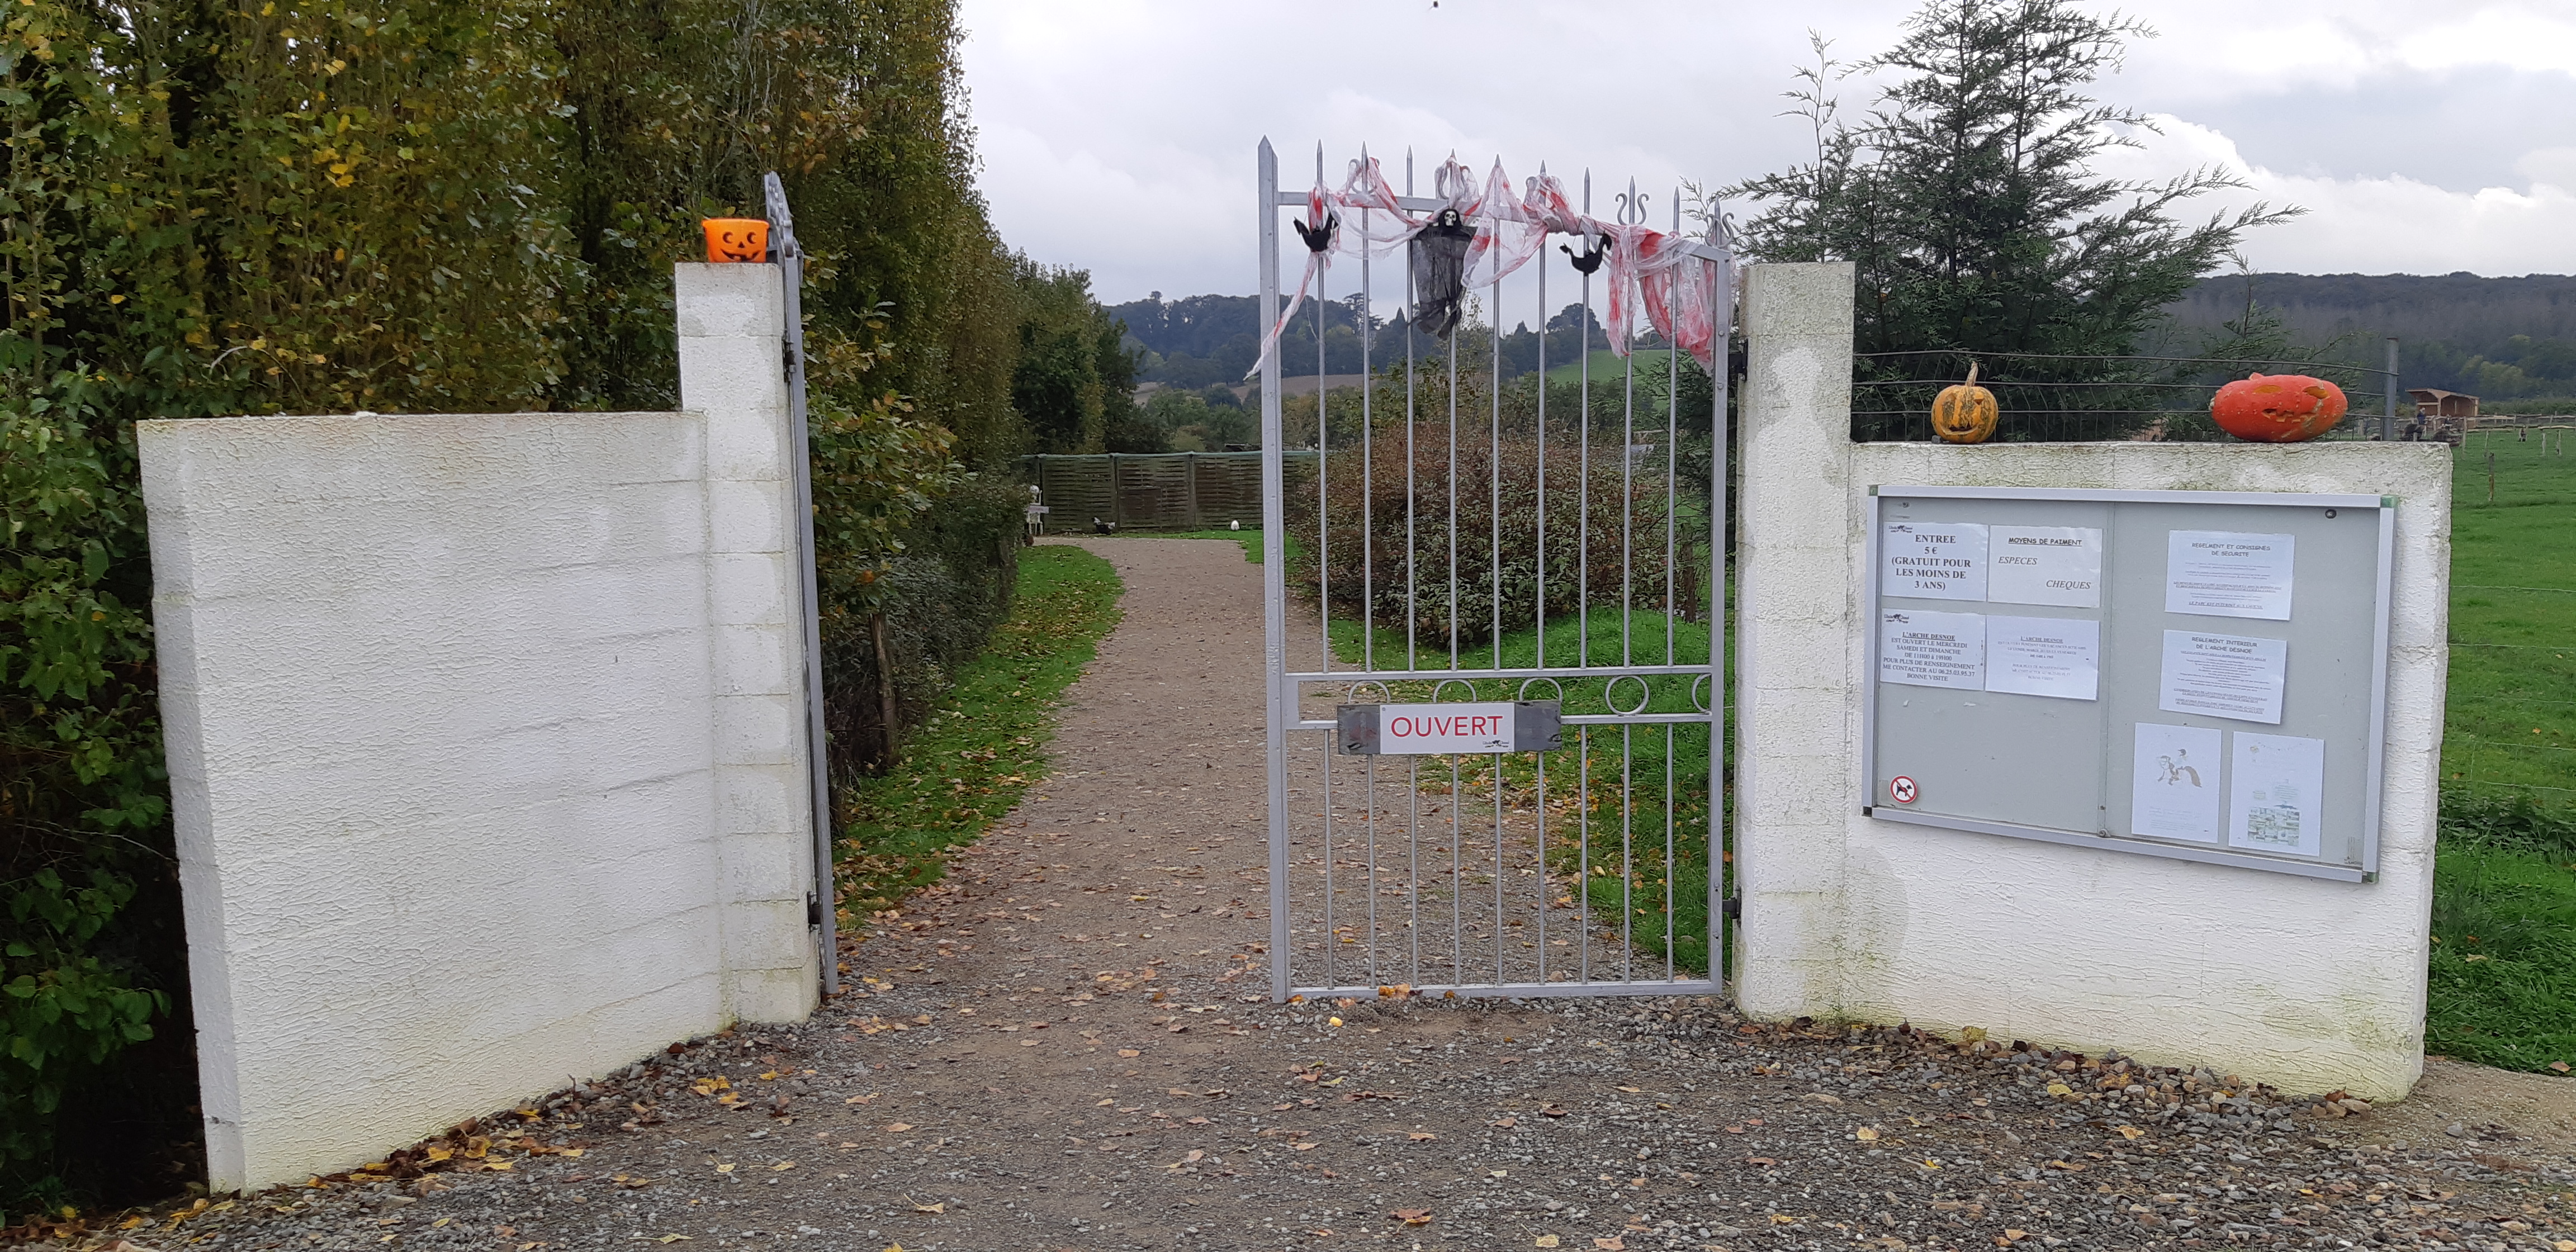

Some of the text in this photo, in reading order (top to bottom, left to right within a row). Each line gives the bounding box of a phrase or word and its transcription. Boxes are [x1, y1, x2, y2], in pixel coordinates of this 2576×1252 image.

[1915, 534, 1956, 544] ENTREE
[1891, 556, 1971, 567] (GRATUIT POUR
[1998, 556, 2038, 565] ESPECES
[1896, 568, 1966, 579] LES MOINS DE
[1922, 581, 1946, 591] ANS)
[2046, 580, 2091, 590] CHEQUES
[1892, 665, 1927, 673] CONTACTER
[1924, 661, 1975, 670] RENSEIGNEMENT
[1390, 715, 1504, 737] OUVERT
